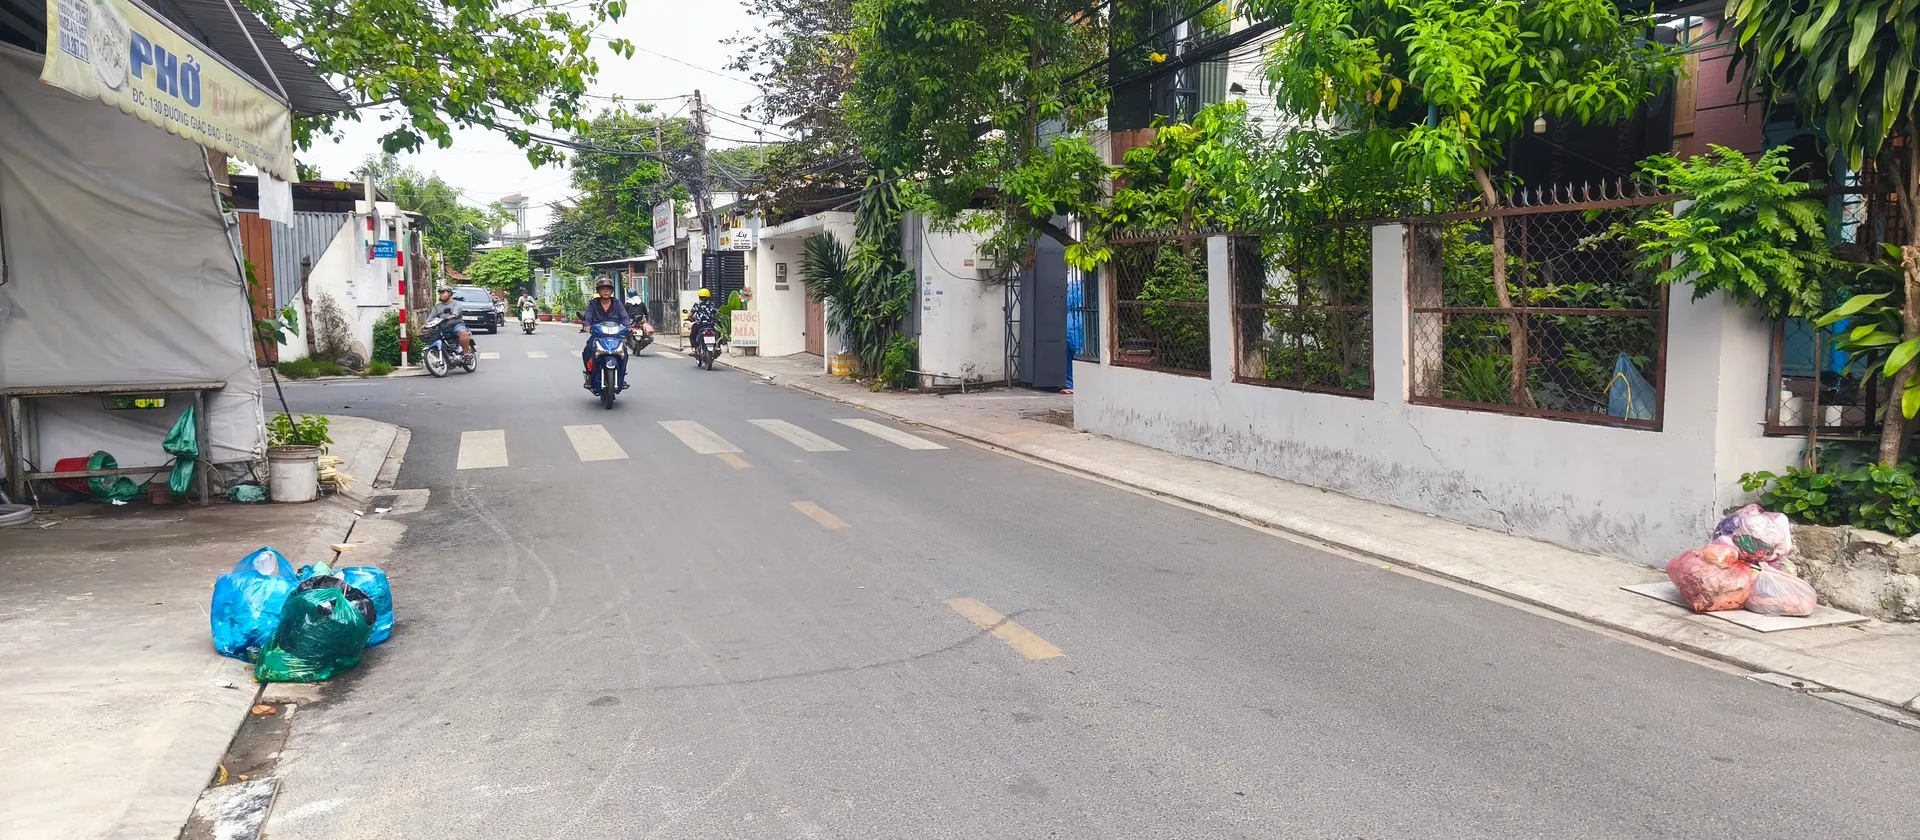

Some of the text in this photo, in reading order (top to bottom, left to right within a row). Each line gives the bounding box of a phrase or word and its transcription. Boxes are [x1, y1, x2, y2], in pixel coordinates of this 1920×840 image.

[129, 28, 201, 108] PHỞ
[132, 87, 148, 107] ĐC:
[149, 96, 163, 115] 130
[164, 103, 189, 126] ĐƯỜNG
[190, 115, 207, 134] GIÁC
[733, 312, 758, 322] NƯỚC
[734, 324, 757, 337] MÍA
